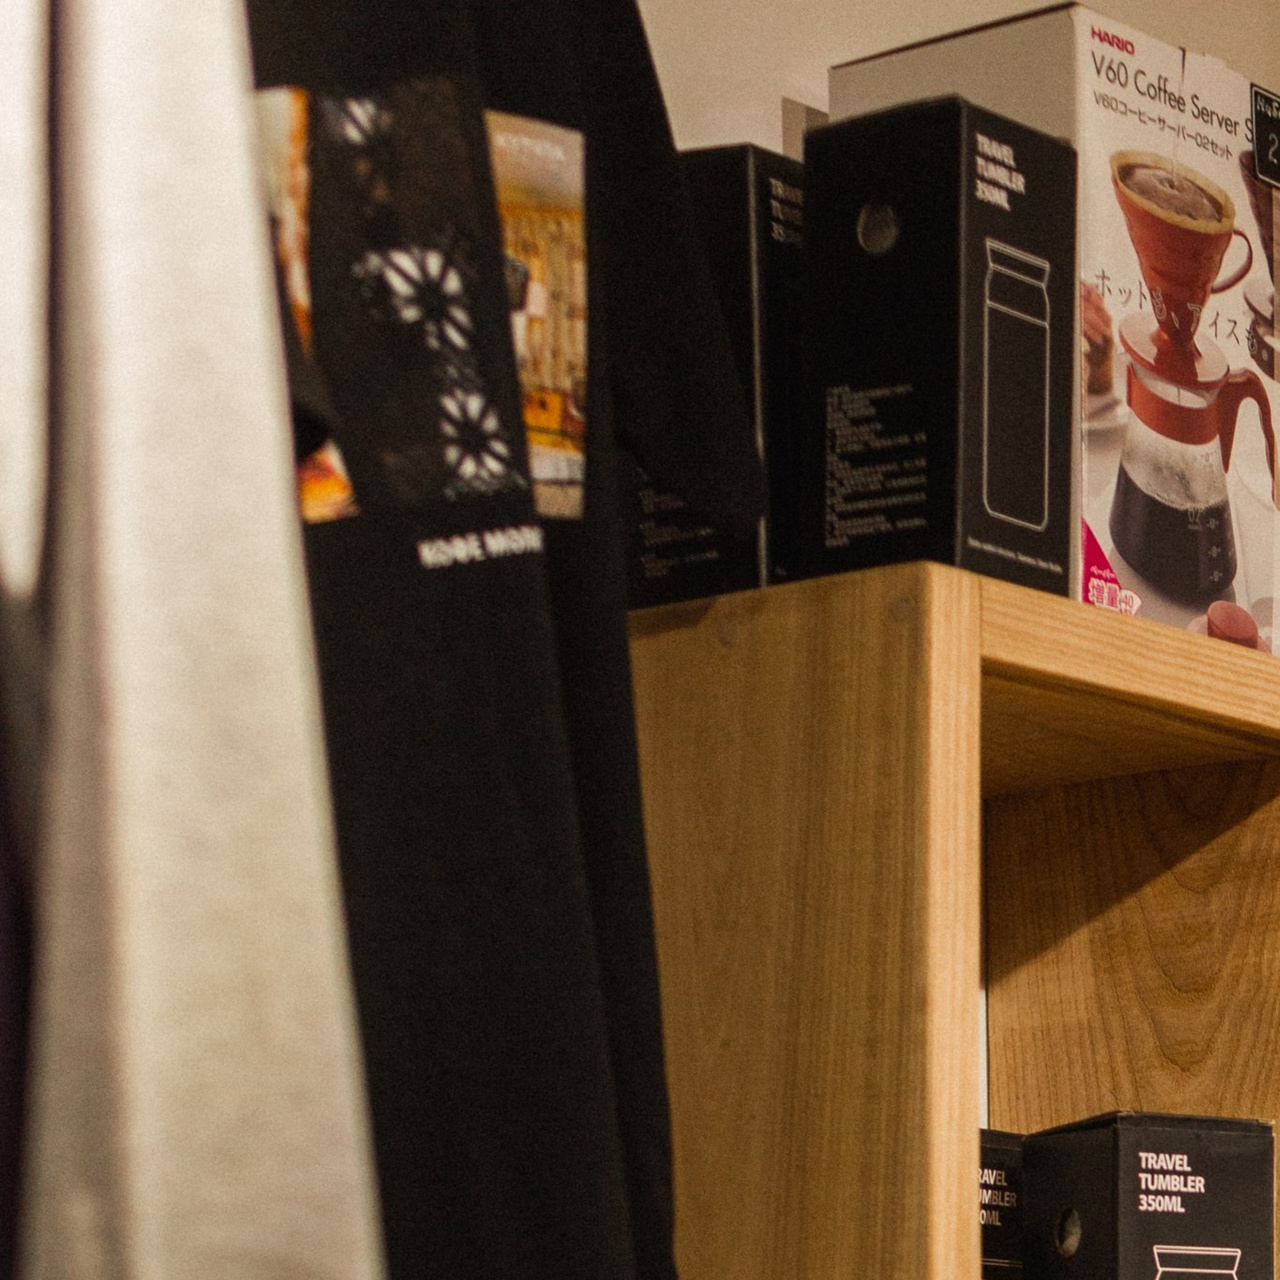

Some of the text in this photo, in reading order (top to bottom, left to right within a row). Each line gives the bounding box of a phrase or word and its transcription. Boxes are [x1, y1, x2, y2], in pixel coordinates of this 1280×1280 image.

[1091, 26, 1135, 55] HARIO
[1091, 50, 1129, 88] V60
[1134, 69, 1186, 113] Coffee
[1191, 94, 1240, 136] Server
[1138, 1152, 1192, 1171] TRAVEL
[977, 1168, 1008, 1186] RAVEL
[1138, 1173, 1205, 1193] TUMBLER
[1138, 1194, 1186, 1213] 350ML
[979, 1209, 1002, 1226] 0ML
